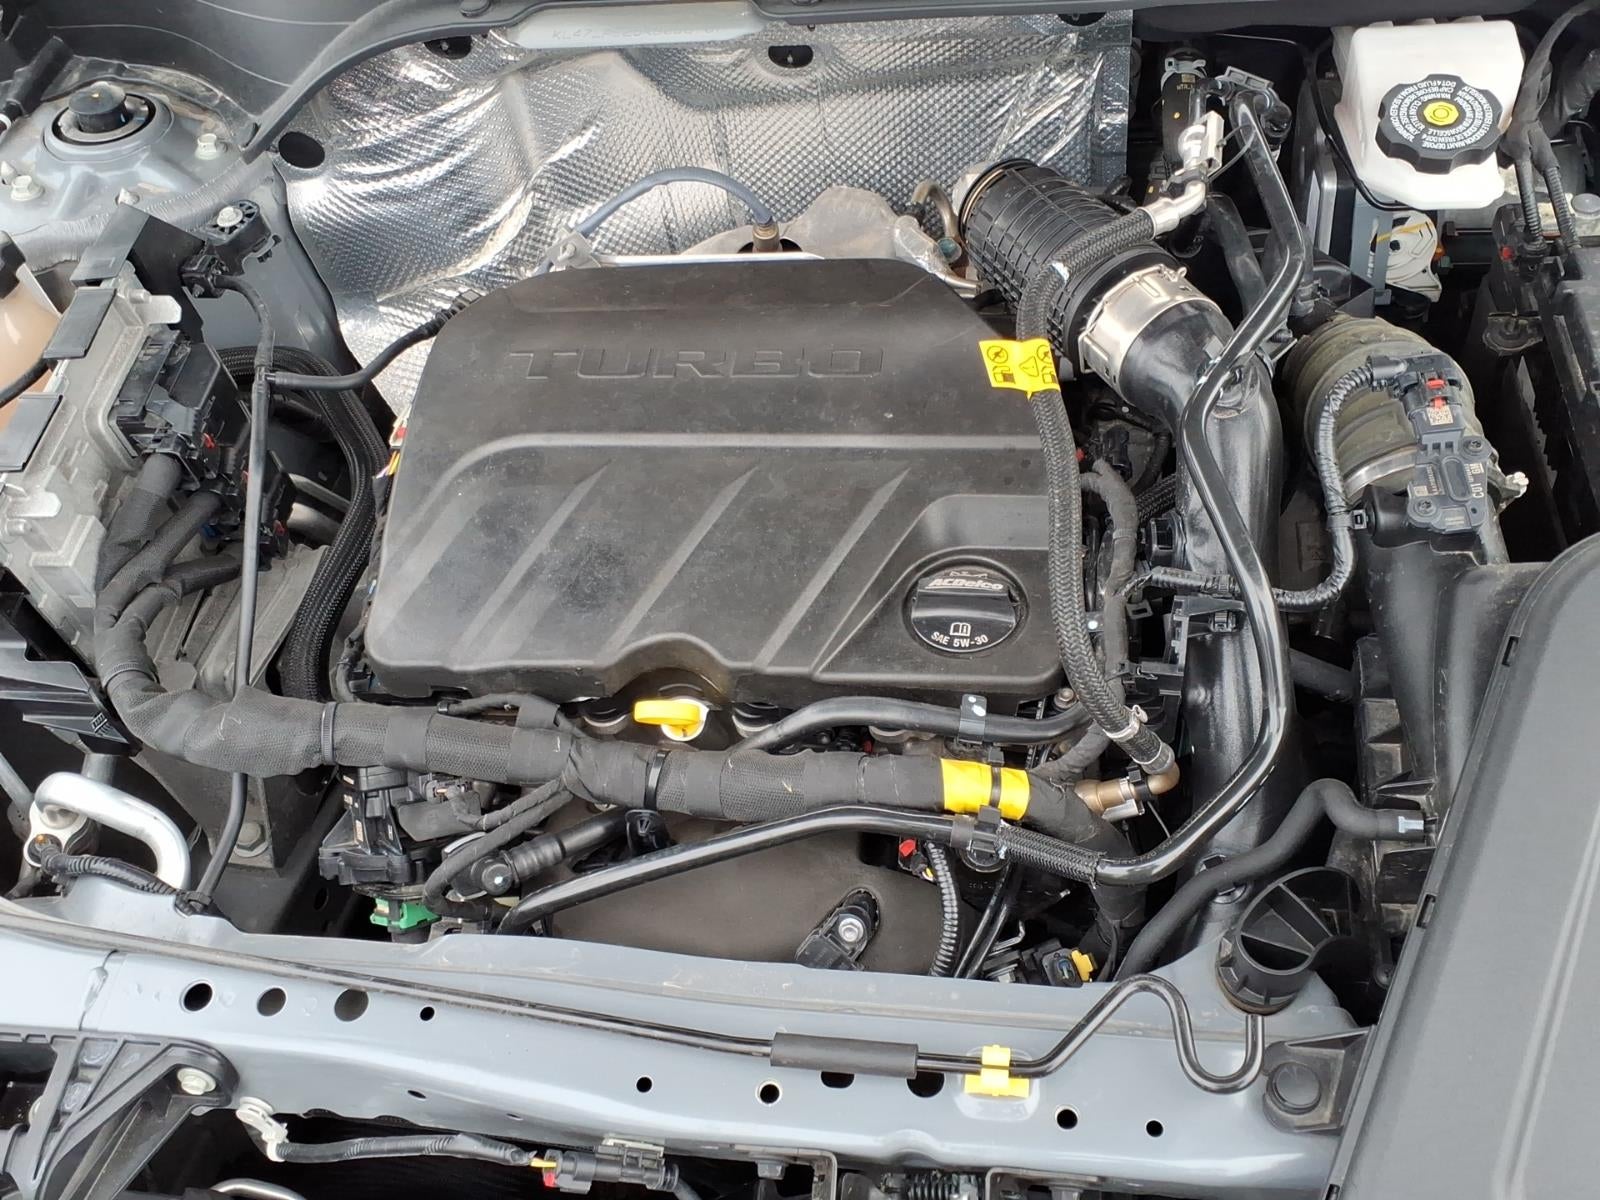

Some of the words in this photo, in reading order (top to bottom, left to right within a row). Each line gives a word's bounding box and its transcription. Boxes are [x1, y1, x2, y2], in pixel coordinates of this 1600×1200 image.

[1416, 80, 1437, 89] FLUID
[509, 348, 884, 380] TURBO
[925, 578, 1004, 590] ACDelco
[931, 631, 950, 645] SAE
[953, 634, 988, 648] 5W-30
